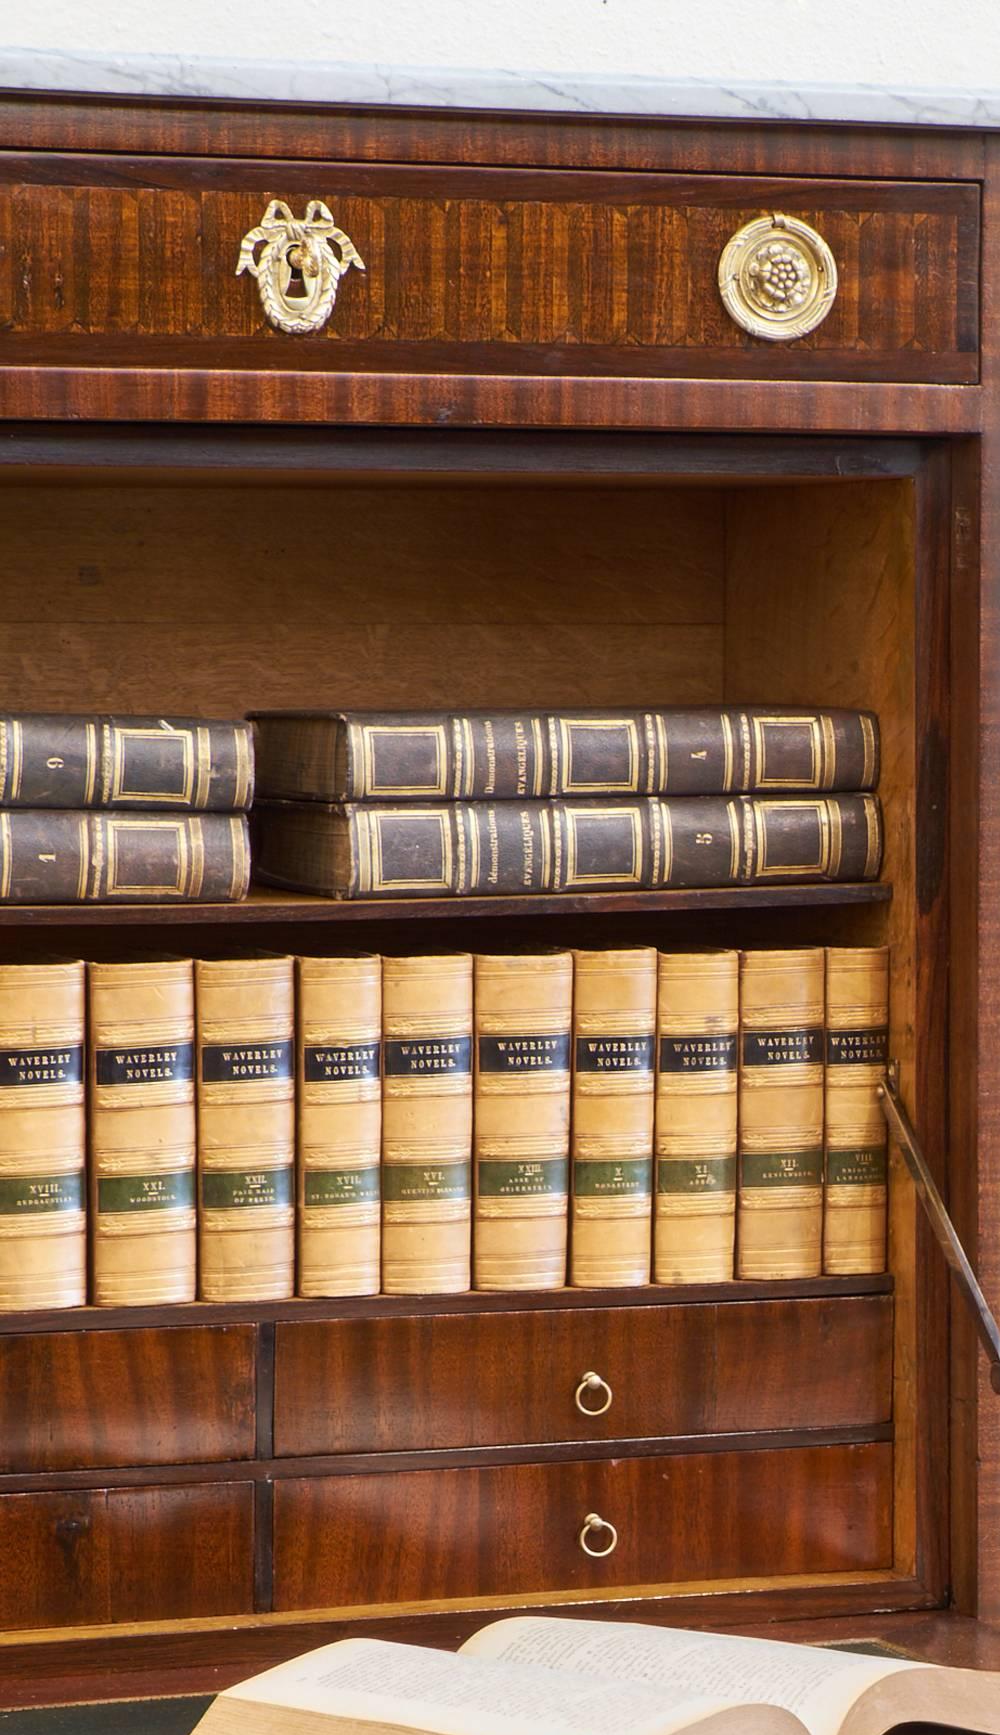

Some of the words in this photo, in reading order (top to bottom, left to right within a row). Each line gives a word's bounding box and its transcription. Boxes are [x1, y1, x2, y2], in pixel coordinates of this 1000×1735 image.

[691, 751, 707, 760] 4
[46, 757, 64, 769] 9
[696, 833, 713, 845] 5
[39, 853, 56, 862] 1
[497, 1040, 558, 1051] WAVERLEY
[757, 1036, 814, 1047] WAVERLEY
[831, 1035, 886, 1046] WAVERLEY
[401, 1043, 461, 1055] WAVERLEY
[588, 1041, 647, 1053] WAVERLEY
[673, 1042, 732, 1053] WAVERLEY
[8, 1054, 71, 1067] WAVERLEY
[115, 1052, 178, 1065] WAVERLEY
[222, 1049, 283, 1061] WAVERLEY
[315, 1050, 375, 1062] WAVERLEY
